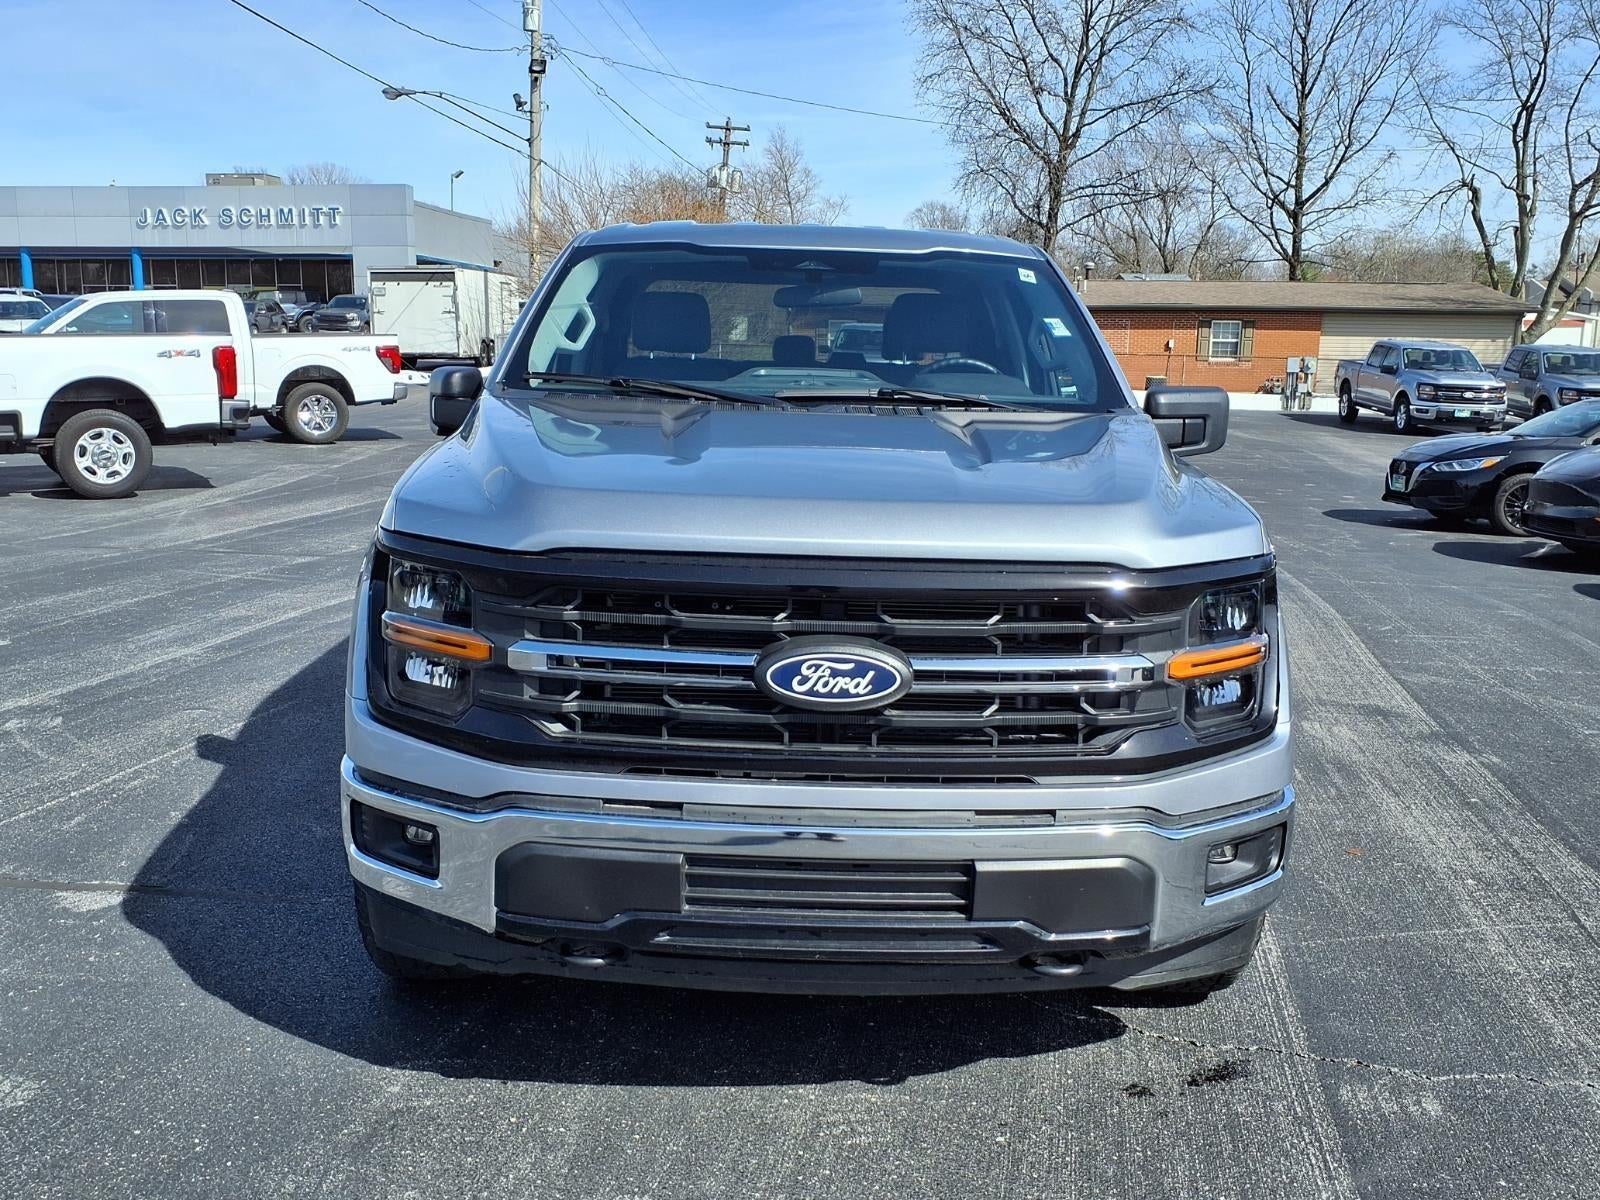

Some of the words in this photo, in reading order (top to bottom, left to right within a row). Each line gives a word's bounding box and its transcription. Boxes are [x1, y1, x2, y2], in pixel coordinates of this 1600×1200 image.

[136, 207, 208, 226] JACK
[218, 207, 342, 227] SCHMITT
[791, 659, 875, 694] Ford
